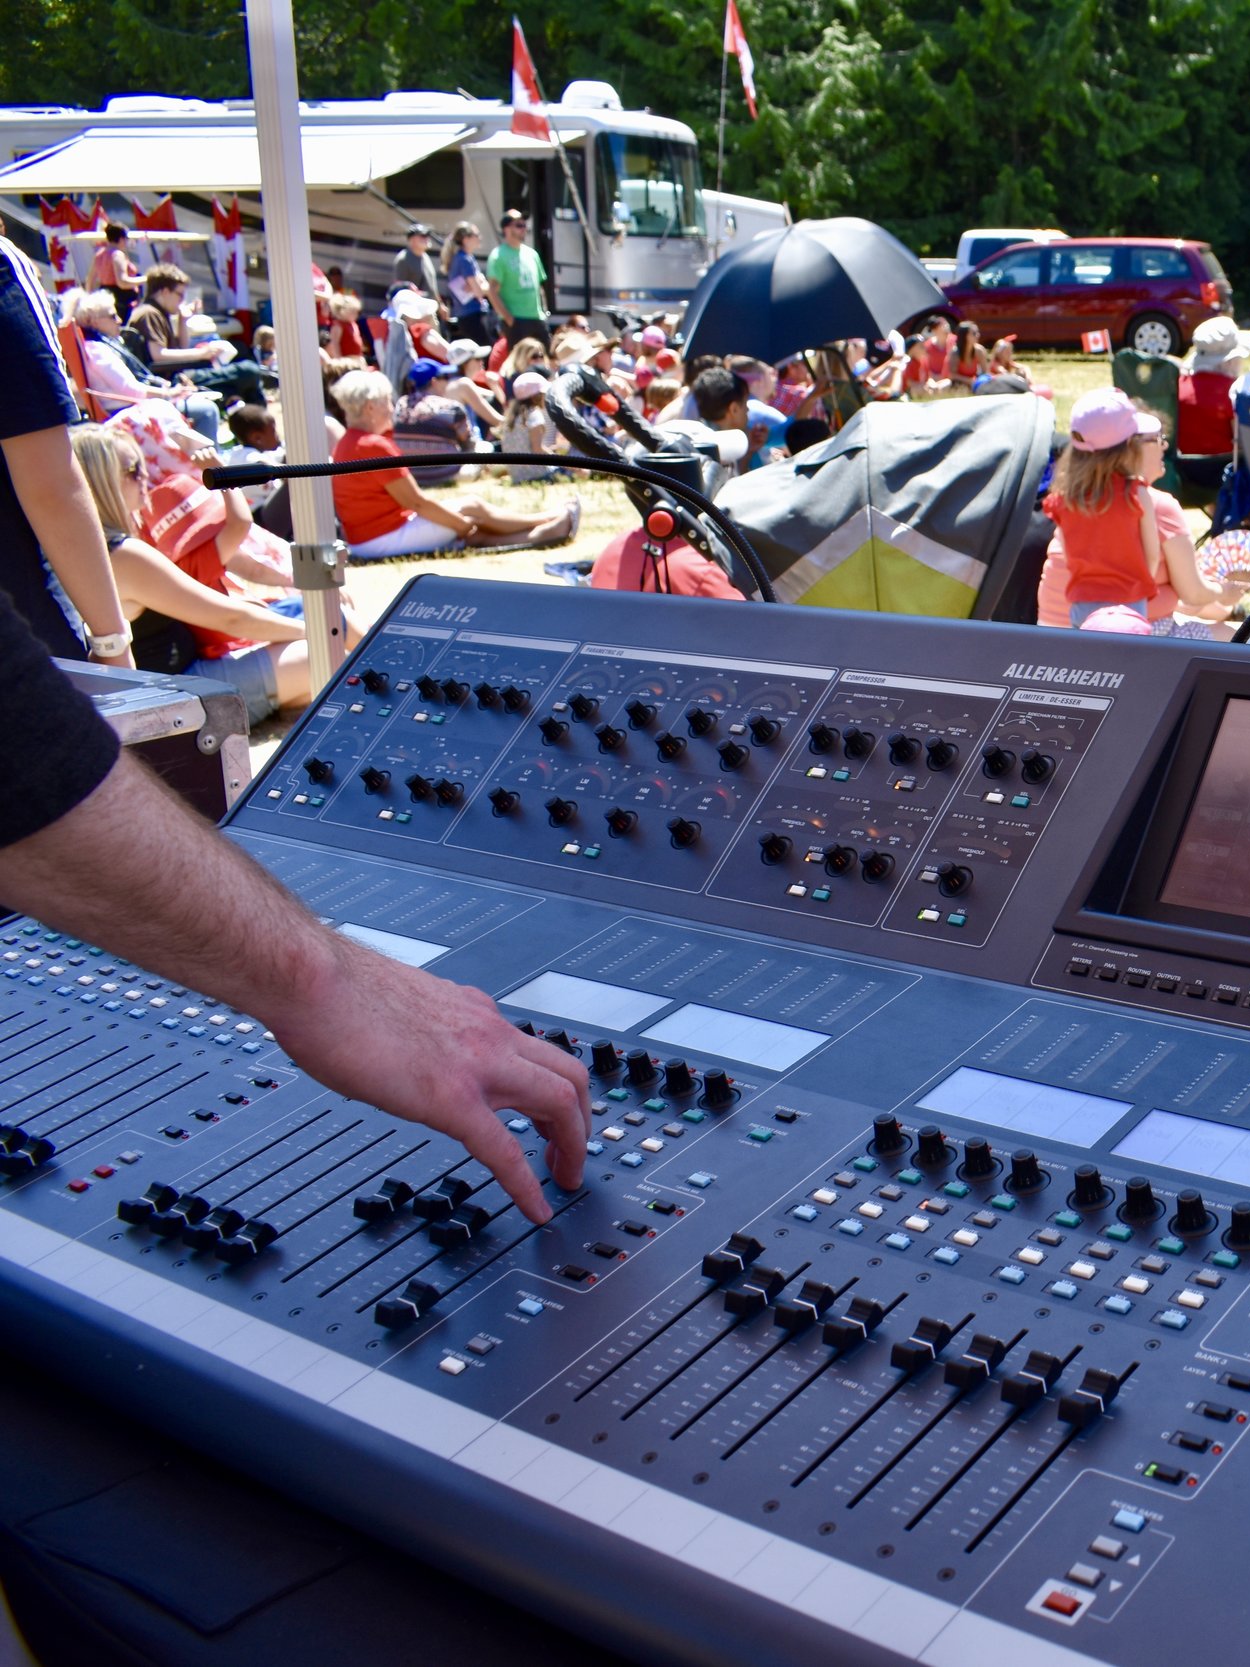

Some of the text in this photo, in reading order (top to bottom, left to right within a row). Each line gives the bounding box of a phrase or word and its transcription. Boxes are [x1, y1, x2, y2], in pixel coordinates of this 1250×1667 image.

[399, 601, 478, 623] iLive-T112
[846, 674, 886, 684] COMPRESSOR
[1002, 663, 1125, 689] ALLEN&HEATH
[1018, 693, 1082, 706] LIMITER DE-ESSER
[781, 818, 806, 827] THRESHOLD
[958, 847, 986, 856] THRESHOLD
[1071, 956, 1093, 965] METERS
[1103, 962, 1117, 970] PAFL
[1127, 966, 1151, 976] ROUTING
[1156, 972, 1182, 982] OUTPUTS
[1218, 983, 1241, 993] SCENES
[637, 1183, 654, 1193] BANK
[623, 1193, 640, 1202] LAYER
[1194, 1351, 1228, 1366] BANK 3
[1183, 1365, 1218, 1380] LAYER A
[1186, 1401, 1195, 1409] B
[1161, 1431, 1170, 1439] C
